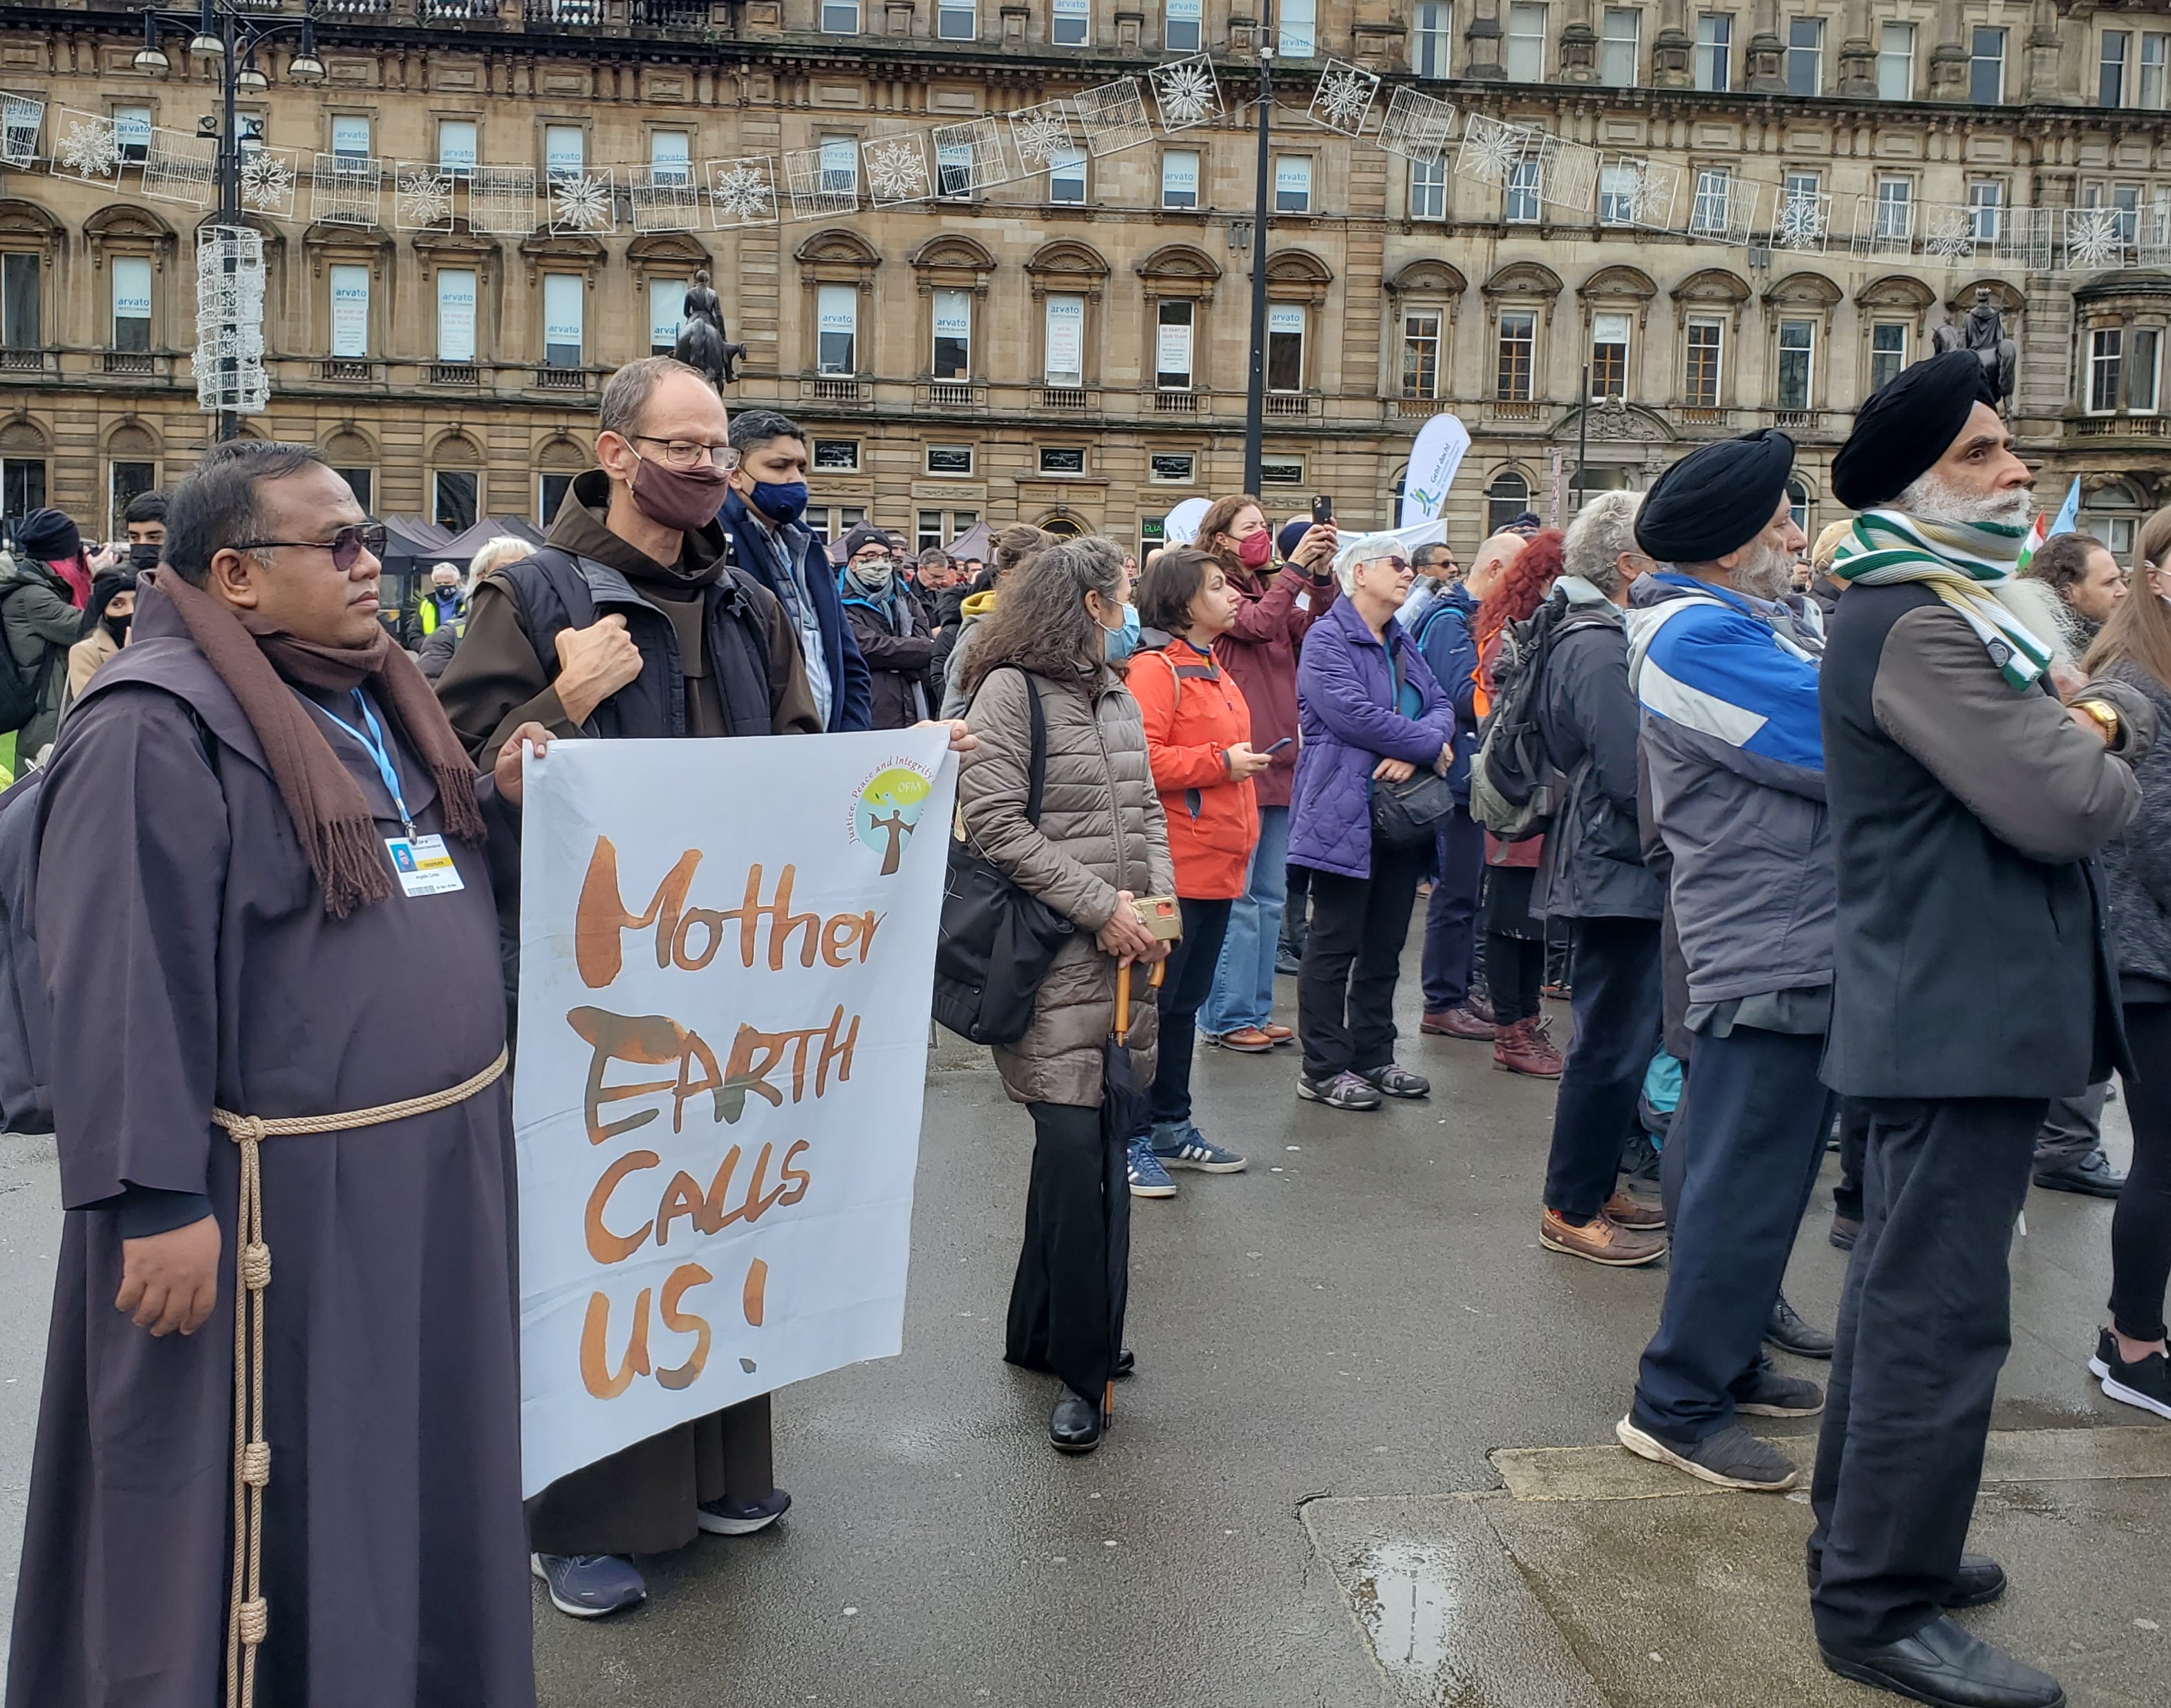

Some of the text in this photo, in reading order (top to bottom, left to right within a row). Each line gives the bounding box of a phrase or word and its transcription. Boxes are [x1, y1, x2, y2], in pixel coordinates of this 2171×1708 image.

[1056, 0, 1086, 8] arvato
[1168, 3, 1198, 11] arvato
[1280, 39, 1309, 47] arvato
[337, 131, 368, 139] arvato
[443, 149, 474, 158] arvato
[550, 152, 580, 160] arvato
[1164, 173, 1193, 181] arvato
[1278, 173, 1307, 181] arvato
[1050, 306, 1079, 314] arvato
[548, 326, 579, 334] arvato
[1431, 464, 1441, 483] Geht
[1439, 442, 1451, 465] doch!
[1144, 524, 1162, 532] ELIA
[897, 781, 922, 793] OFM
[846, 756, 933, 845] Justice, Peace and Integrity
[575, 834, 888, 989] Mother
[566, 1004, 861, 1145] EARTH
[584, 1138, 812, 1266] CALLS
